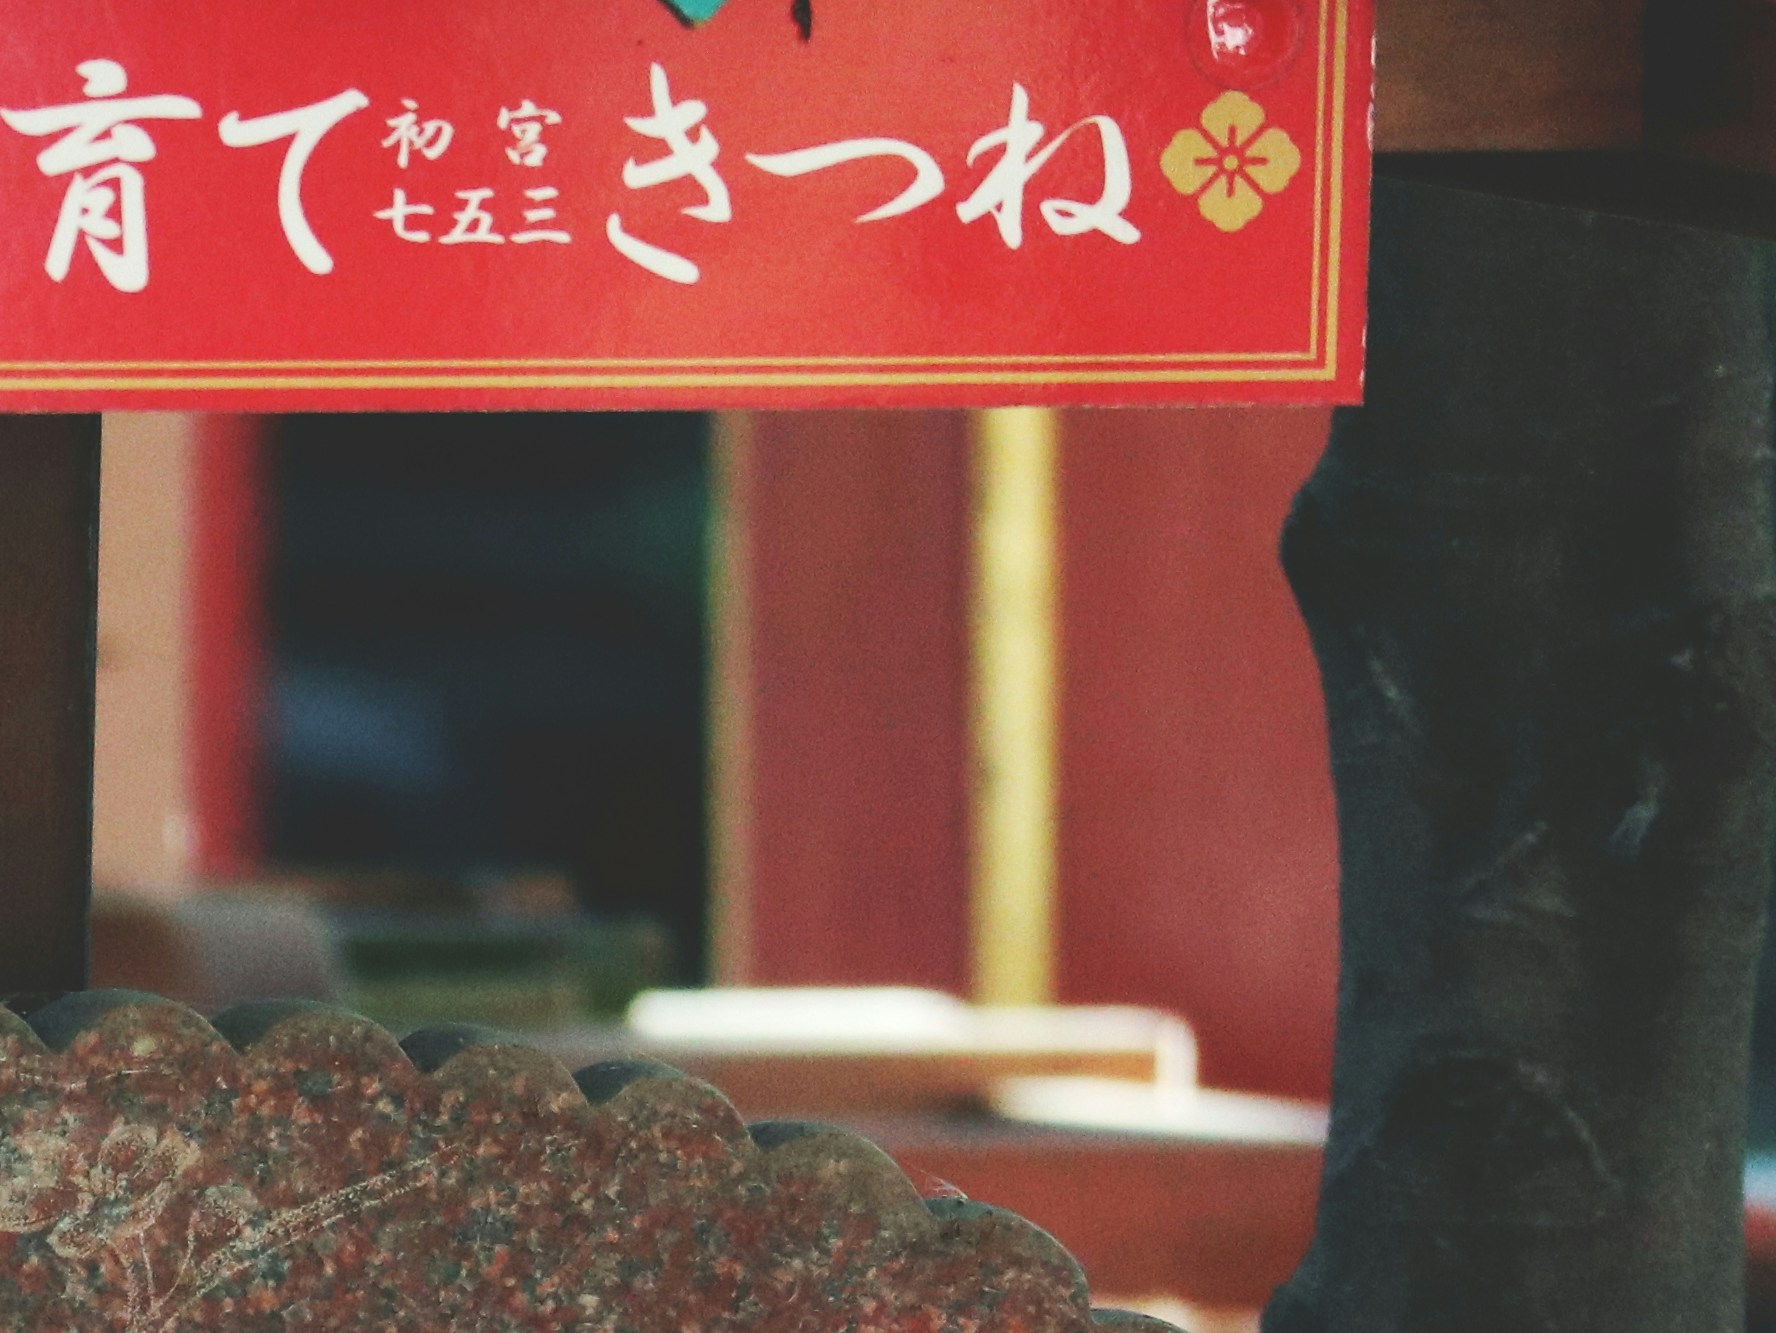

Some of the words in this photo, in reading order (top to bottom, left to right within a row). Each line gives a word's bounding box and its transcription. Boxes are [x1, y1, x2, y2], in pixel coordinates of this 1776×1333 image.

[374, 187, 571, 244] 七五三
[606, 62, 1142, 284] きつね
